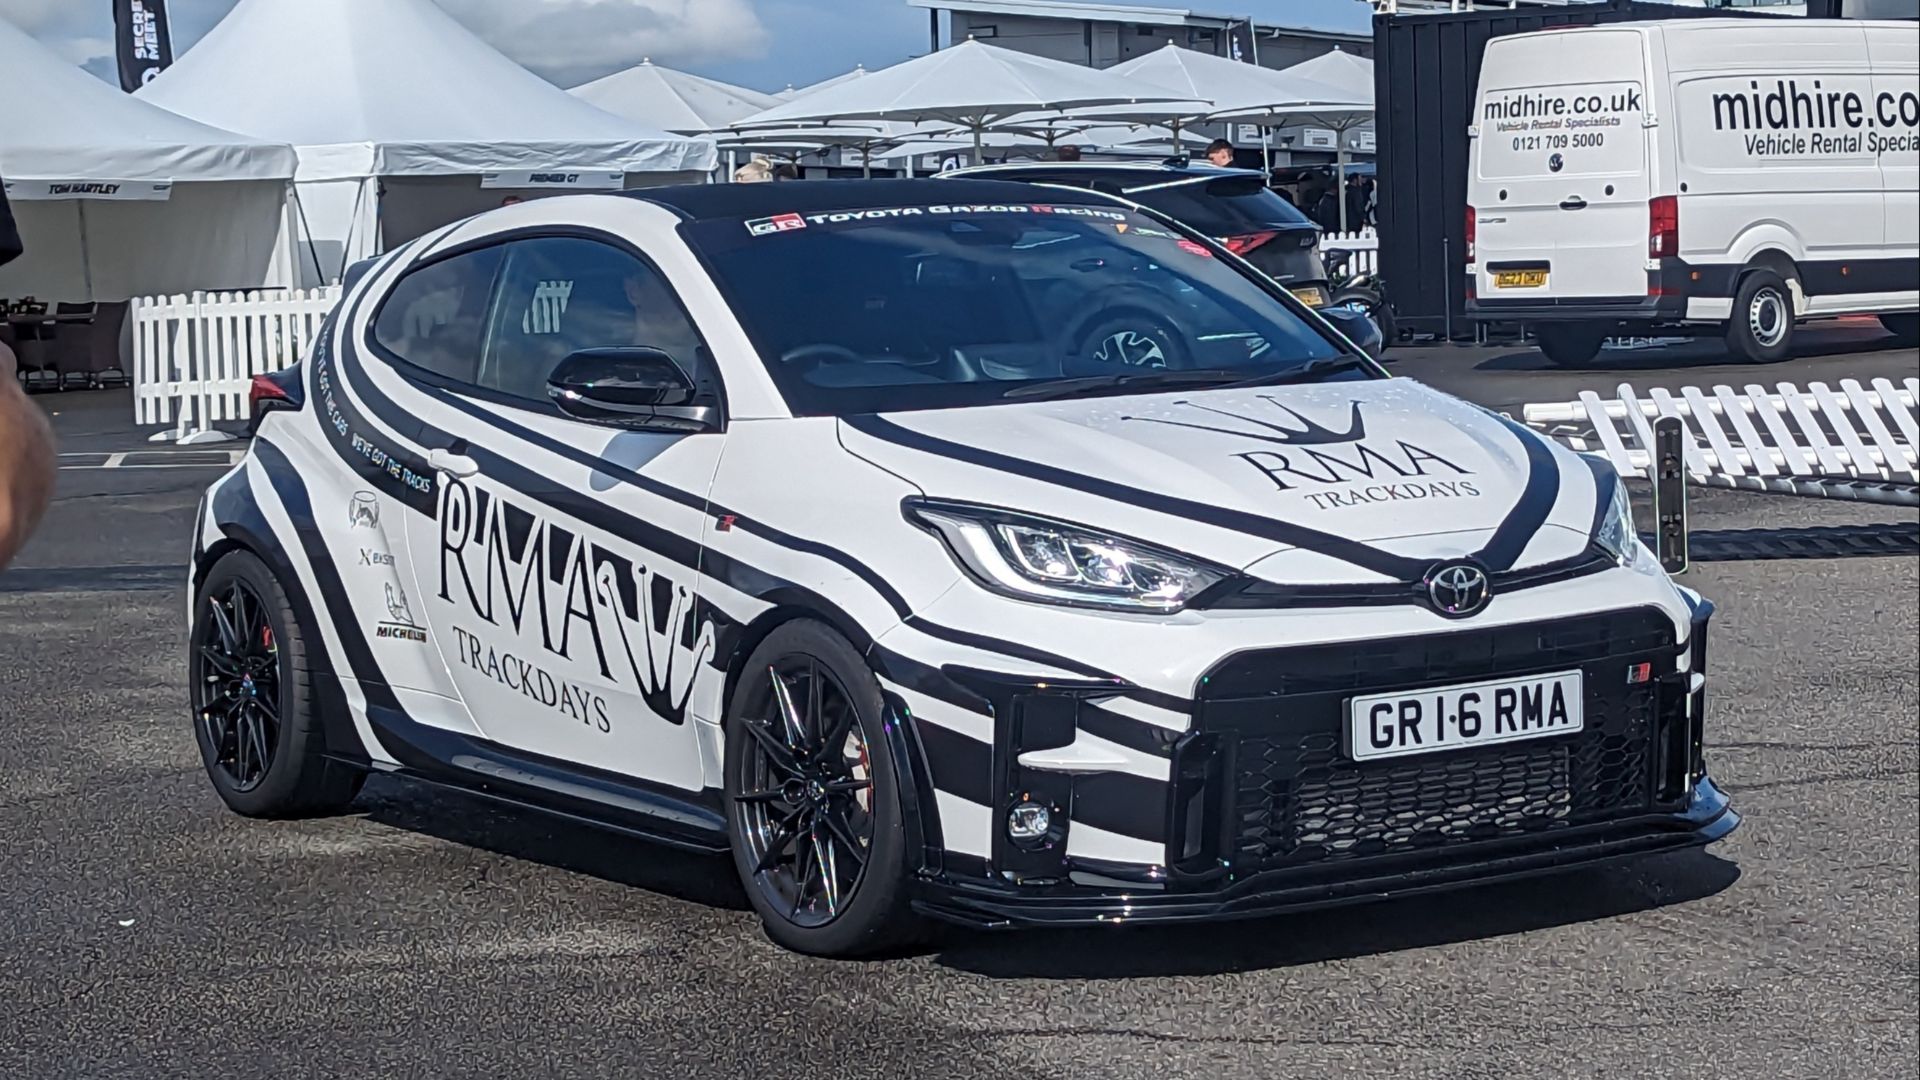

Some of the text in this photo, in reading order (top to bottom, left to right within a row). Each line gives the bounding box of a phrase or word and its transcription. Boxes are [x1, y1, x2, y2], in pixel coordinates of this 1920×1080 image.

[143, 10, 159, 60] MEET
[1485, 88, 1641, 120] midhire.co.uk
[1713, 80, 1919, 130] midhire.co
[1497, 116, 1621, 132] Vehicle Rental Specialists
[1512, 132, 1604, 151] 0121 709 5000
[1745, 132, 1805, 155] Vehicle
[1811, 132, 1862, 153] Rental
[49, 183, 120, 194] TOM HARTLEY
[567, 173, 580, 182] GT
[751, 204, 1126, 235] GR TOYOTA GAZOO Racing
[371, 448, 387, 468] GOT
[387, 458, 402, 479] THE
[401, 468, 431, 493] TRACKS
[1229, 440, 1476, 491] RMA
[1304, 481, 1481, 510] TRACKDAYS
[438, 477, 618, 683] RMA
[376, 625, 427, 643] MICHELIN
[453, 626, 611, 733] TRACKDAYS
[1495, 681, 1568, 735] RMA
